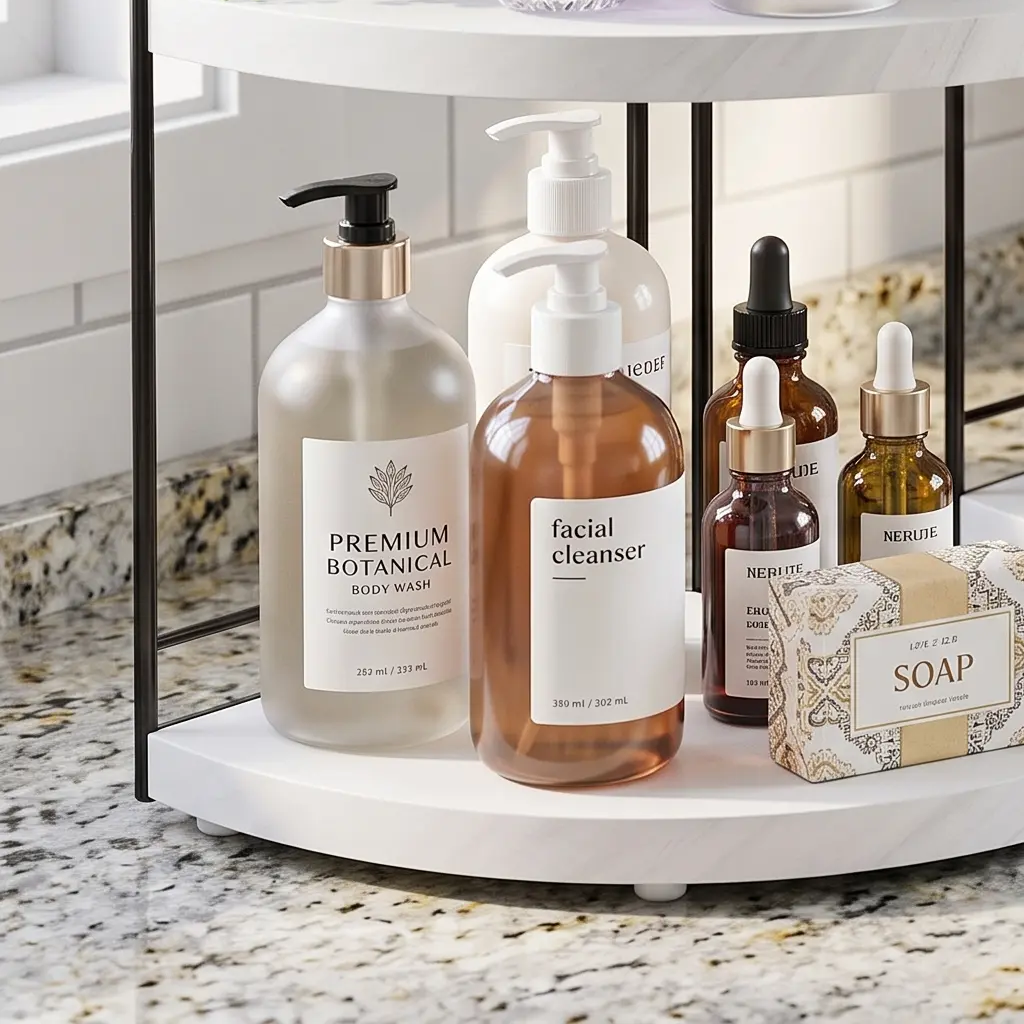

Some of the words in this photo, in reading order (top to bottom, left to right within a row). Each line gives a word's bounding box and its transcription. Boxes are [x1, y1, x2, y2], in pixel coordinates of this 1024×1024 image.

[330, 524, 448, 553] PREMIUM
[551, 516, 614, 539] facial
[327, 550, 452, 576] BOTANICAL
[552, 543, 646, 564] cleanser
[352, 584, 390, 596] BODY
[394, 579, 431, 593] WASH
[893, 653, 974, 692] SOAP
[572, 699, 585, 708] ml
